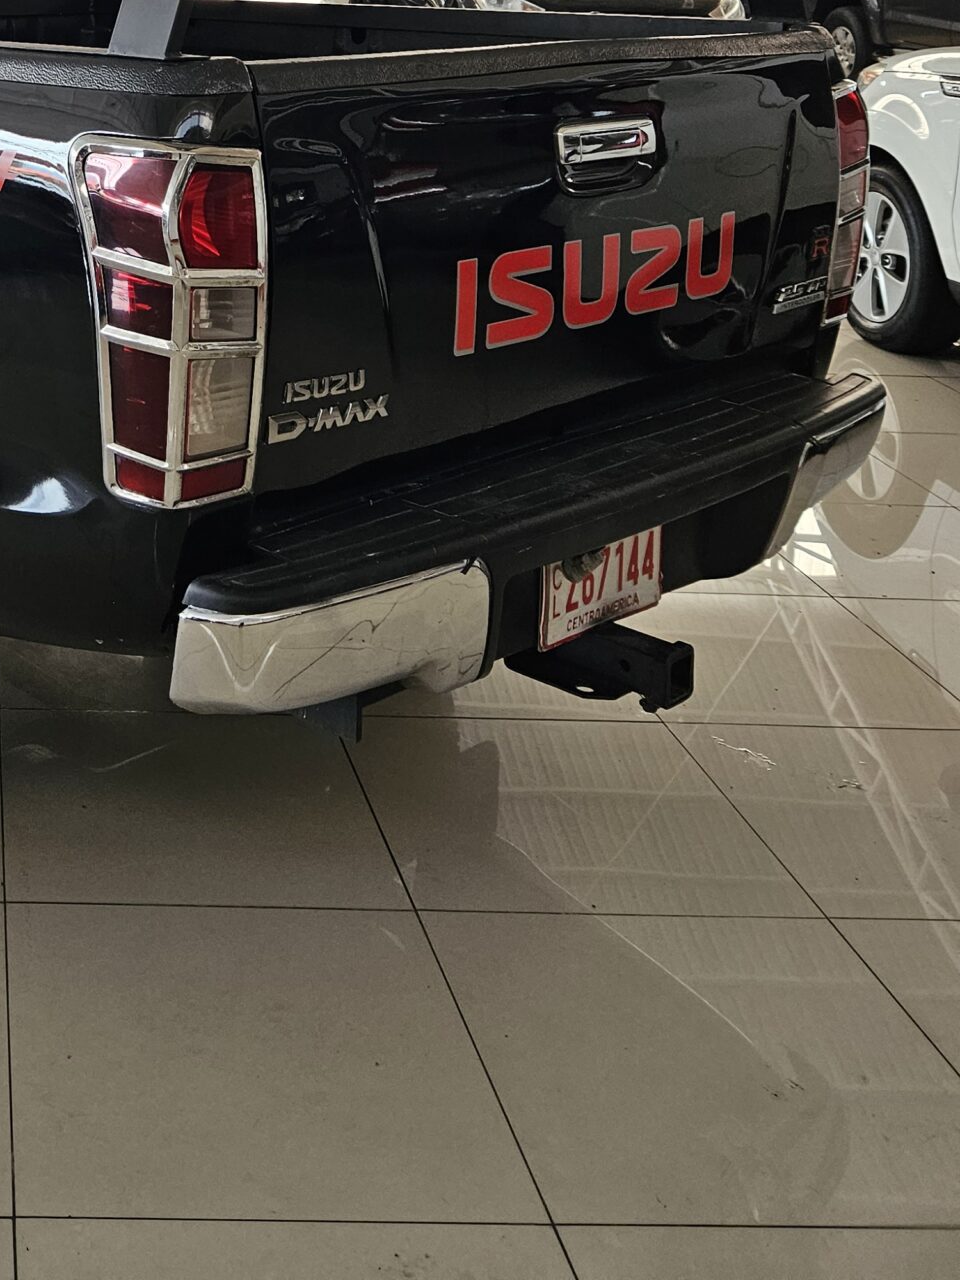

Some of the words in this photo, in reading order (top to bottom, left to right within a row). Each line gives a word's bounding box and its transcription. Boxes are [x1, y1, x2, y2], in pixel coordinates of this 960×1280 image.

[454, 211, 735, 357] ISUZU
[283, 368, 365, 404] ISUZU
[267, 393, 390, 445] D-MAX
[566, 592, 640, 632] CENTROAMERICA
